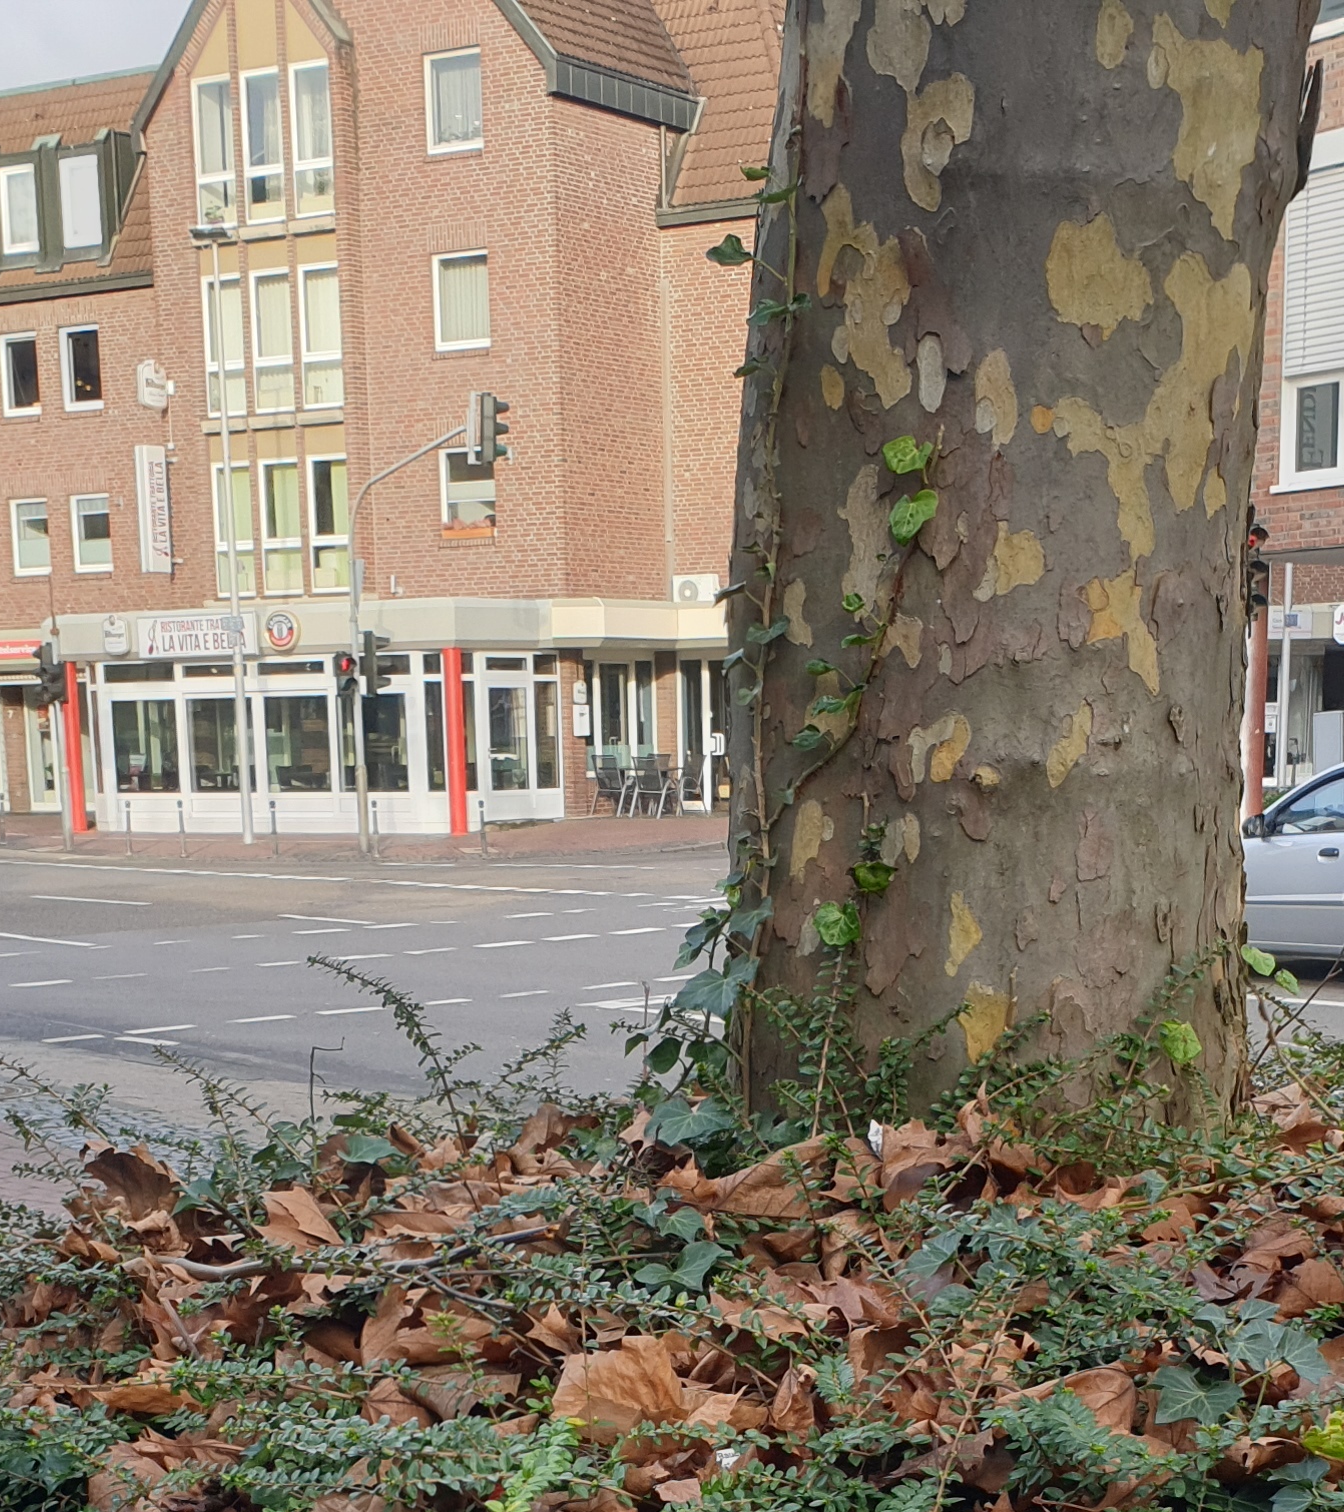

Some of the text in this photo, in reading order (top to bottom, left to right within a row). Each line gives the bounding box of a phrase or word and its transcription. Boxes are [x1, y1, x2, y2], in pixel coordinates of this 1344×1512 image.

[154, 462, 164, 493] BELLA
[157, 506, 166, 527] VITA
[158, 531, 167, 543] LA
[160, 619, 204, 633] RISTORANTE
[162, 631, 246, 652] LA VITA E BELA
